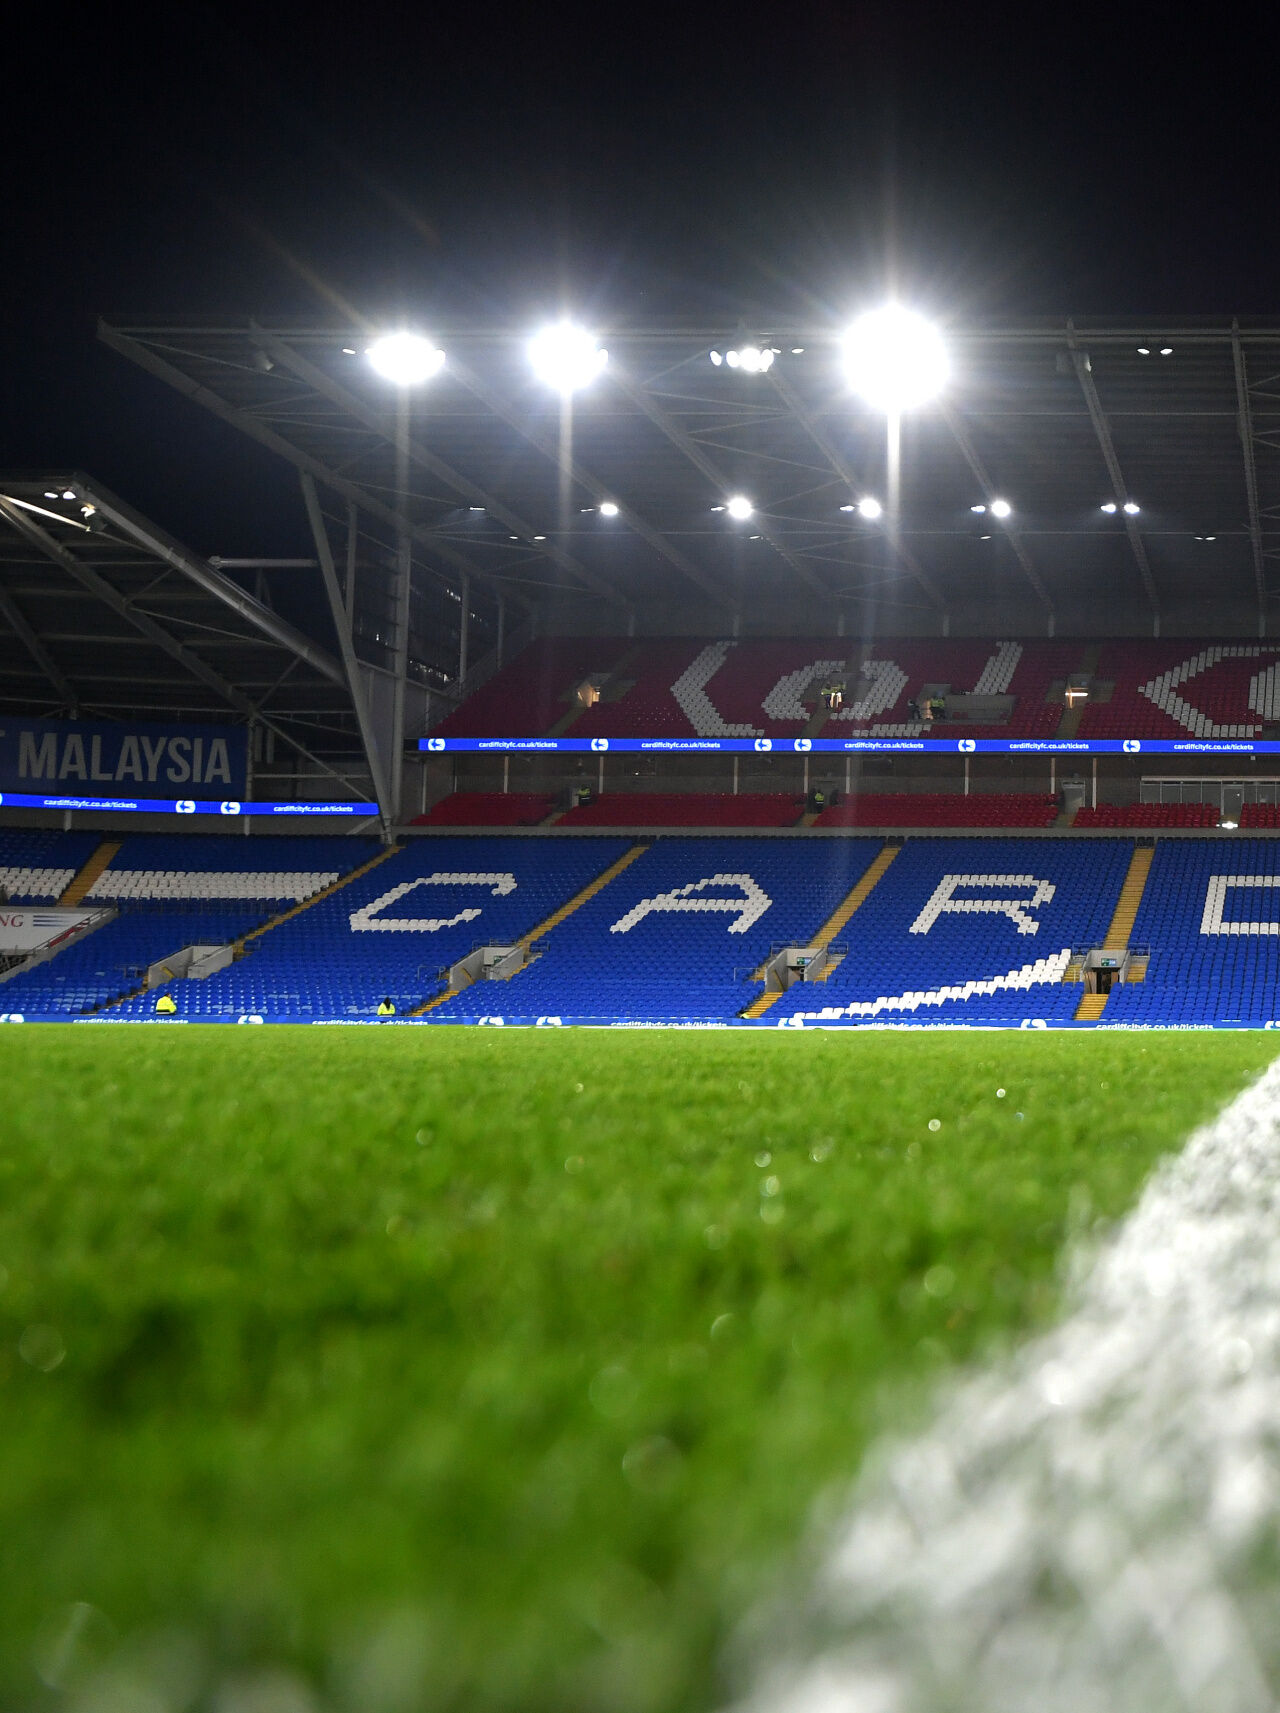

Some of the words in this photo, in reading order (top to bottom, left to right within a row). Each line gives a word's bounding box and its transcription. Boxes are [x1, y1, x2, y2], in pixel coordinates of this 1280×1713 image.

[478, 741, 558, 749] cardiffcityfc.co.uk/tickets
[641, 741, 721, 749] cardiffcityfc.co.uk/tickets
[844, 741, 925, 749] cardiffcityfc.co.uk/tickets
[1009, 742, 1090, 750] cardiffcityfc.co.uk/tickets
[1173, 743, 1254, 751] cardiffcityfc.co.uk/tickets
[18, 731, 232, 784] MALAYSIA
[43, 798, 138, 809] cardiffcityfc.co.uk/tickets
[273, 805, 354, 813] cardiffcityfc.co.uk/tickets
